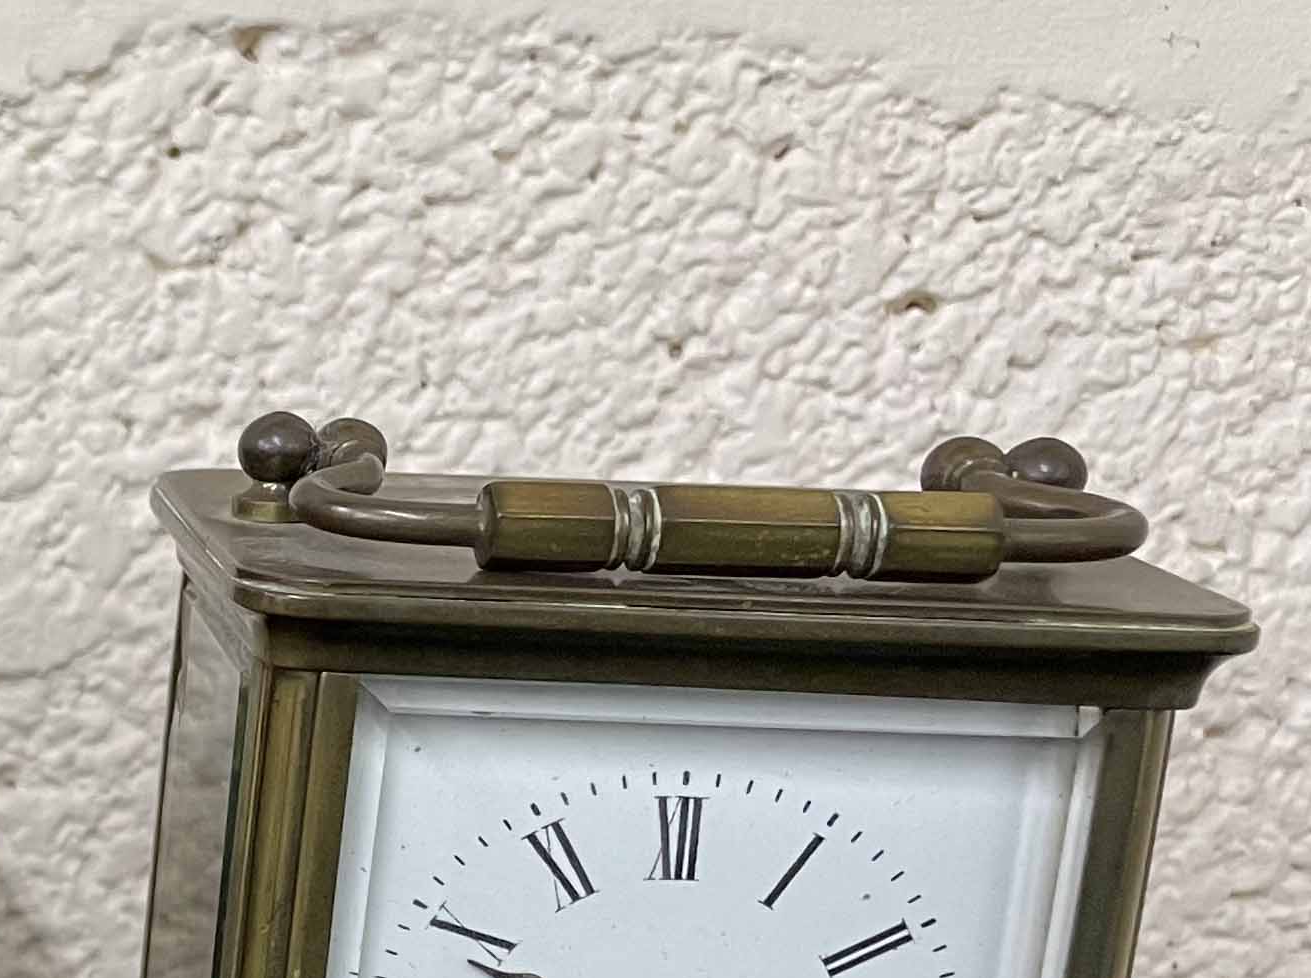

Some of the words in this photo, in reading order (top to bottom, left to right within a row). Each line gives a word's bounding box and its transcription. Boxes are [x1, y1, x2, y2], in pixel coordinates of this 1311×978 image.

[522, 817, 601, 913] XI
[643, 795, 710, 882] XII
[758, 832, 825, 910] I
[428, 901, 523, 965] X
